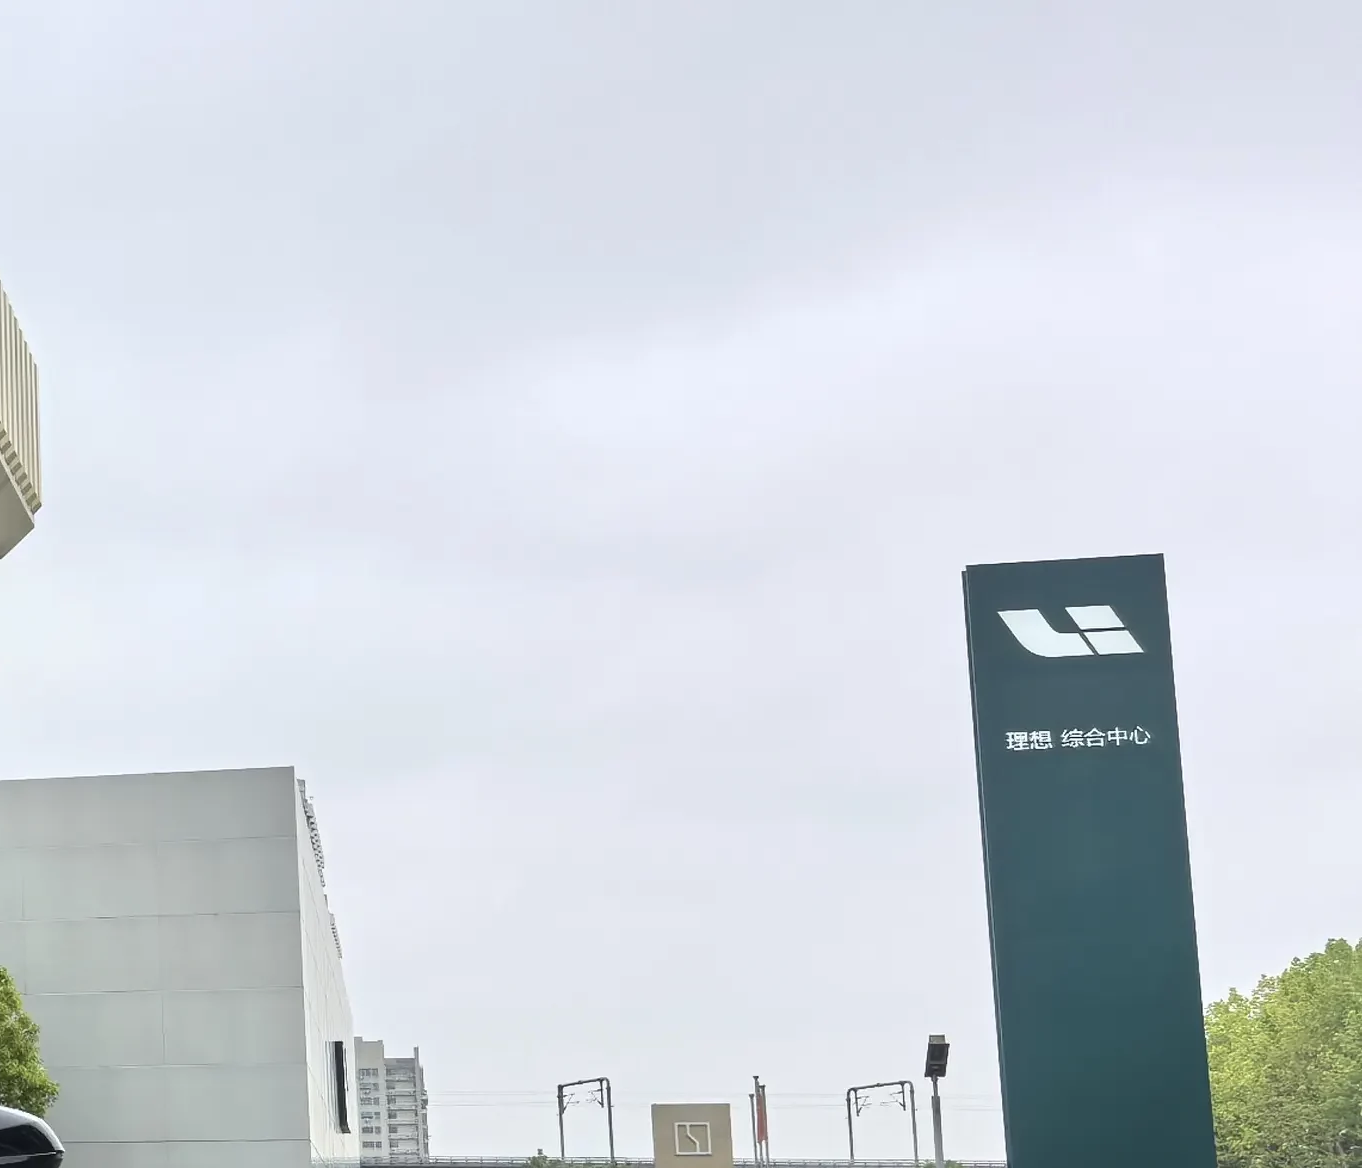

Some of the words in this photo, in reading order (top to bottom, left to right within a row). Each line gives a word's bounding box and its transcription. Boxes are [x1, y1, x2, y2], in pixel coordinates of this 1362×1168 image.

[1005, 730, 1053, 751] 理想
[1061, 726, 1151, 748] 综合中心
